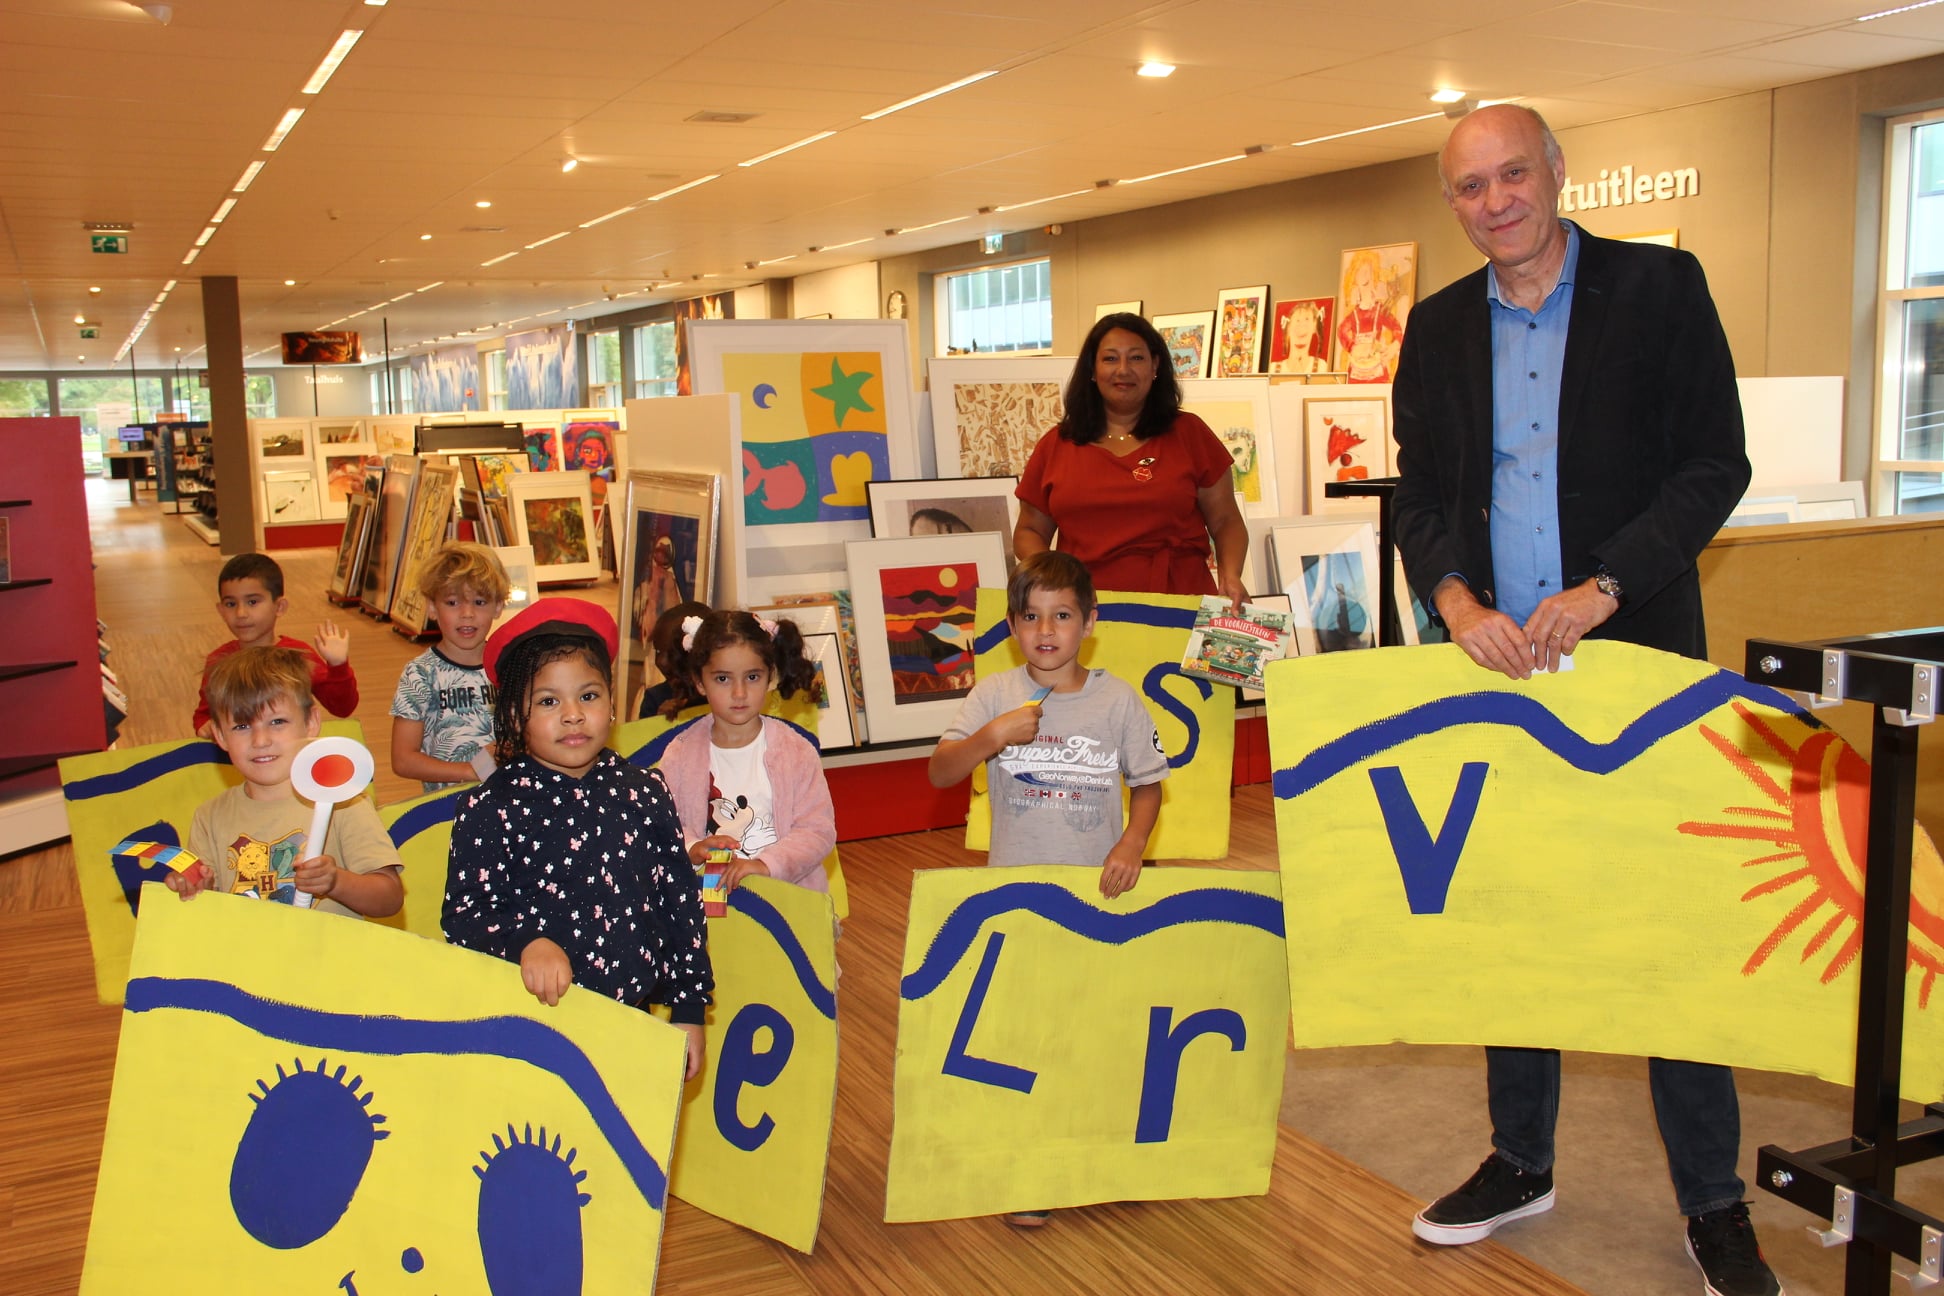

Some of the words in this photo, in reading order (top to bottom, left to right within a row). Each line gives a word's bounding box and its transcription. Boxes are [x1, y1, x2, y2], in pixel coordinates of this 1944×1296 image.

[1213, 618, 1223, 627] DE
[439, 686, 475, 710] SURF
[1368, 762, 1489, 914] V
[261, 875, 275, 892] H
[714, 1003, 795, 1152] e
